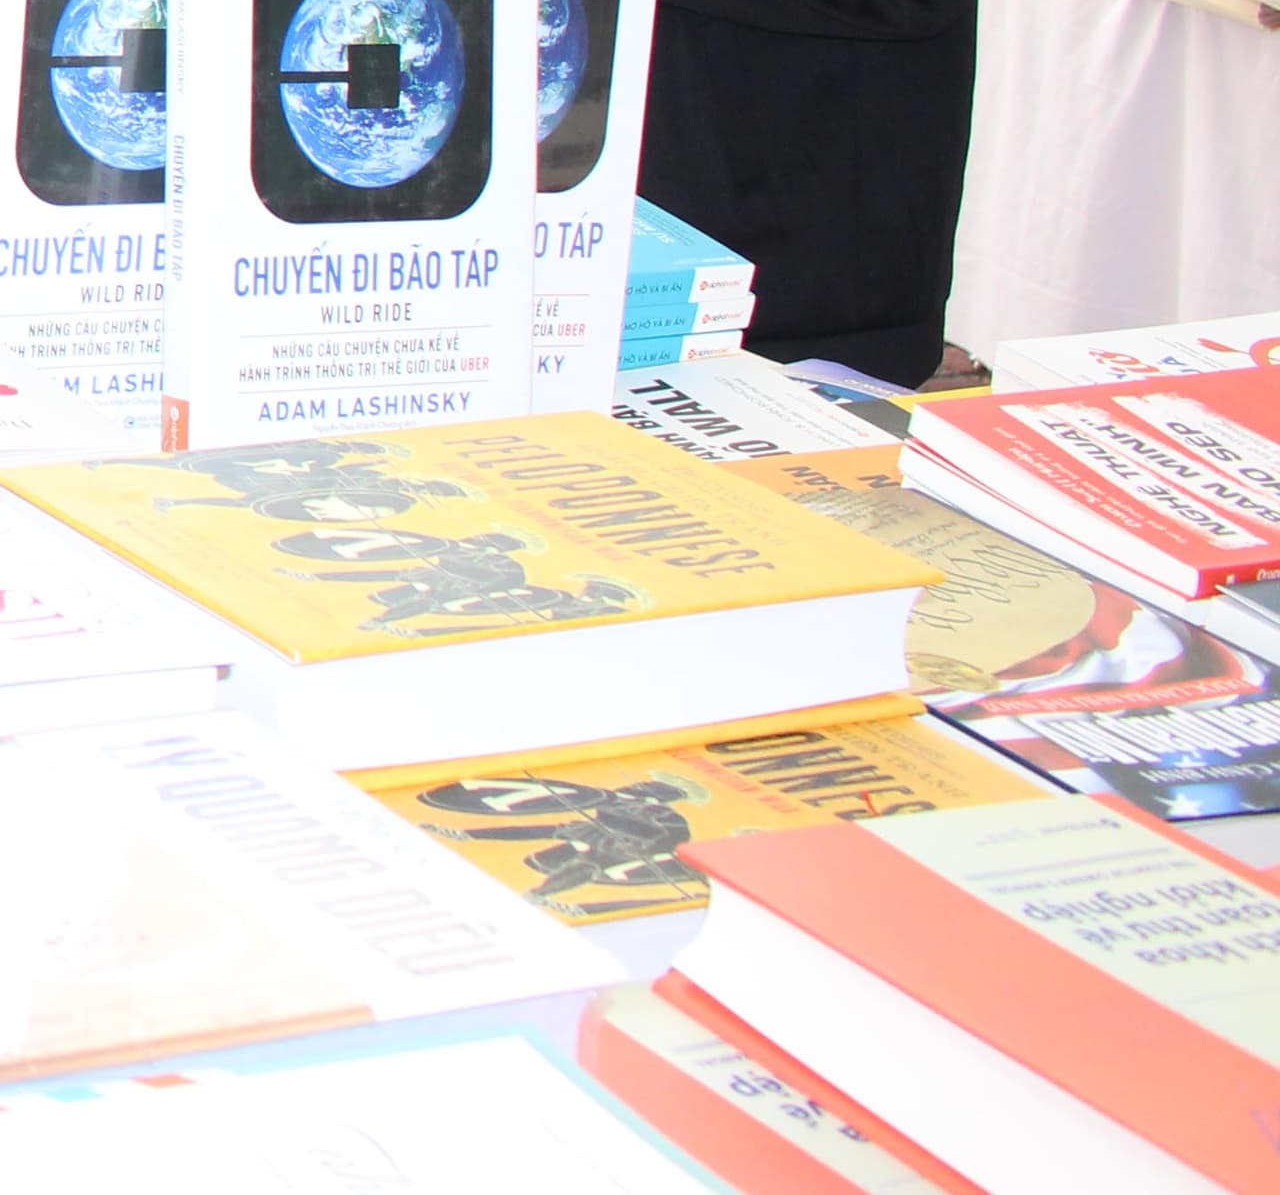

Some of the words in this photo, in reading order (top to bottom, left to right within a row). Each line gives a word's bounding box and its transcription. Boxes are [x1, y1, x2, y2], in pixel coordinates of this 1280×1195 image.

[558, 211, 603, 258] TÁP
[115, 234, 143, 272] ĐI
[234, 240, 342, 297] CHUYẾN
[352, 253, 378, 292] ĐI
[390, 244, 441, 291] BÃO
[451, 238, 499, 289] TÁP
[81, 284, 125, 303] WILD
[134, 283, 164, 302] RID
[28, 321, 70, 338] NHỮNG
[75, 320, 97, 336] CÂU
[103, 317, 149, 335] CHUYỆN
[321, 304, 364, 324] WILD
[373, 302, 413, 322] RIDE
[558, 322, 586, 336] UBER
[31, 342, 66, 358] TRÌNH
[140, 337, 161, 354] THẾ
[272, 341, 313, 359] NHỮNG
[318, 338, 340, 356] CÂU
[344, 338, 389, 356] CHUYỆN
[393, 337, 424, 354] CHƯA
[428, 331, 442, 352] KỂ
[446, 332, 460, 351] VỀ
[92, 372, 164, 394] LASHI
[239, 362, 271, 383] HÀNH
[276, 362, 310, 381] TRÌNH
[316, 360, 353, 379] THỐNG
[358, 362, 376, 379] TRỊ
[381, 356, 401, 375] THẾ
[406, 357, 430, 375] GIỚI
[434, 354, 456, 373] CỦA
[460, 356, 489, 372] UBER
[258, 398, 326, 422] ADAM
[337, 390, 472, 419] LASHINSKY
[629, 379, 743, 437] WALL
[1039, 419, 1141, 479] THUẬT
[1140, 484, 1236, 538] NGHỆ
[442, 435, 776, 578] PELOPONNESE
[1023, 890, 1158, 924] nghiệp
[1133, 940, 1248, 967] khoa
